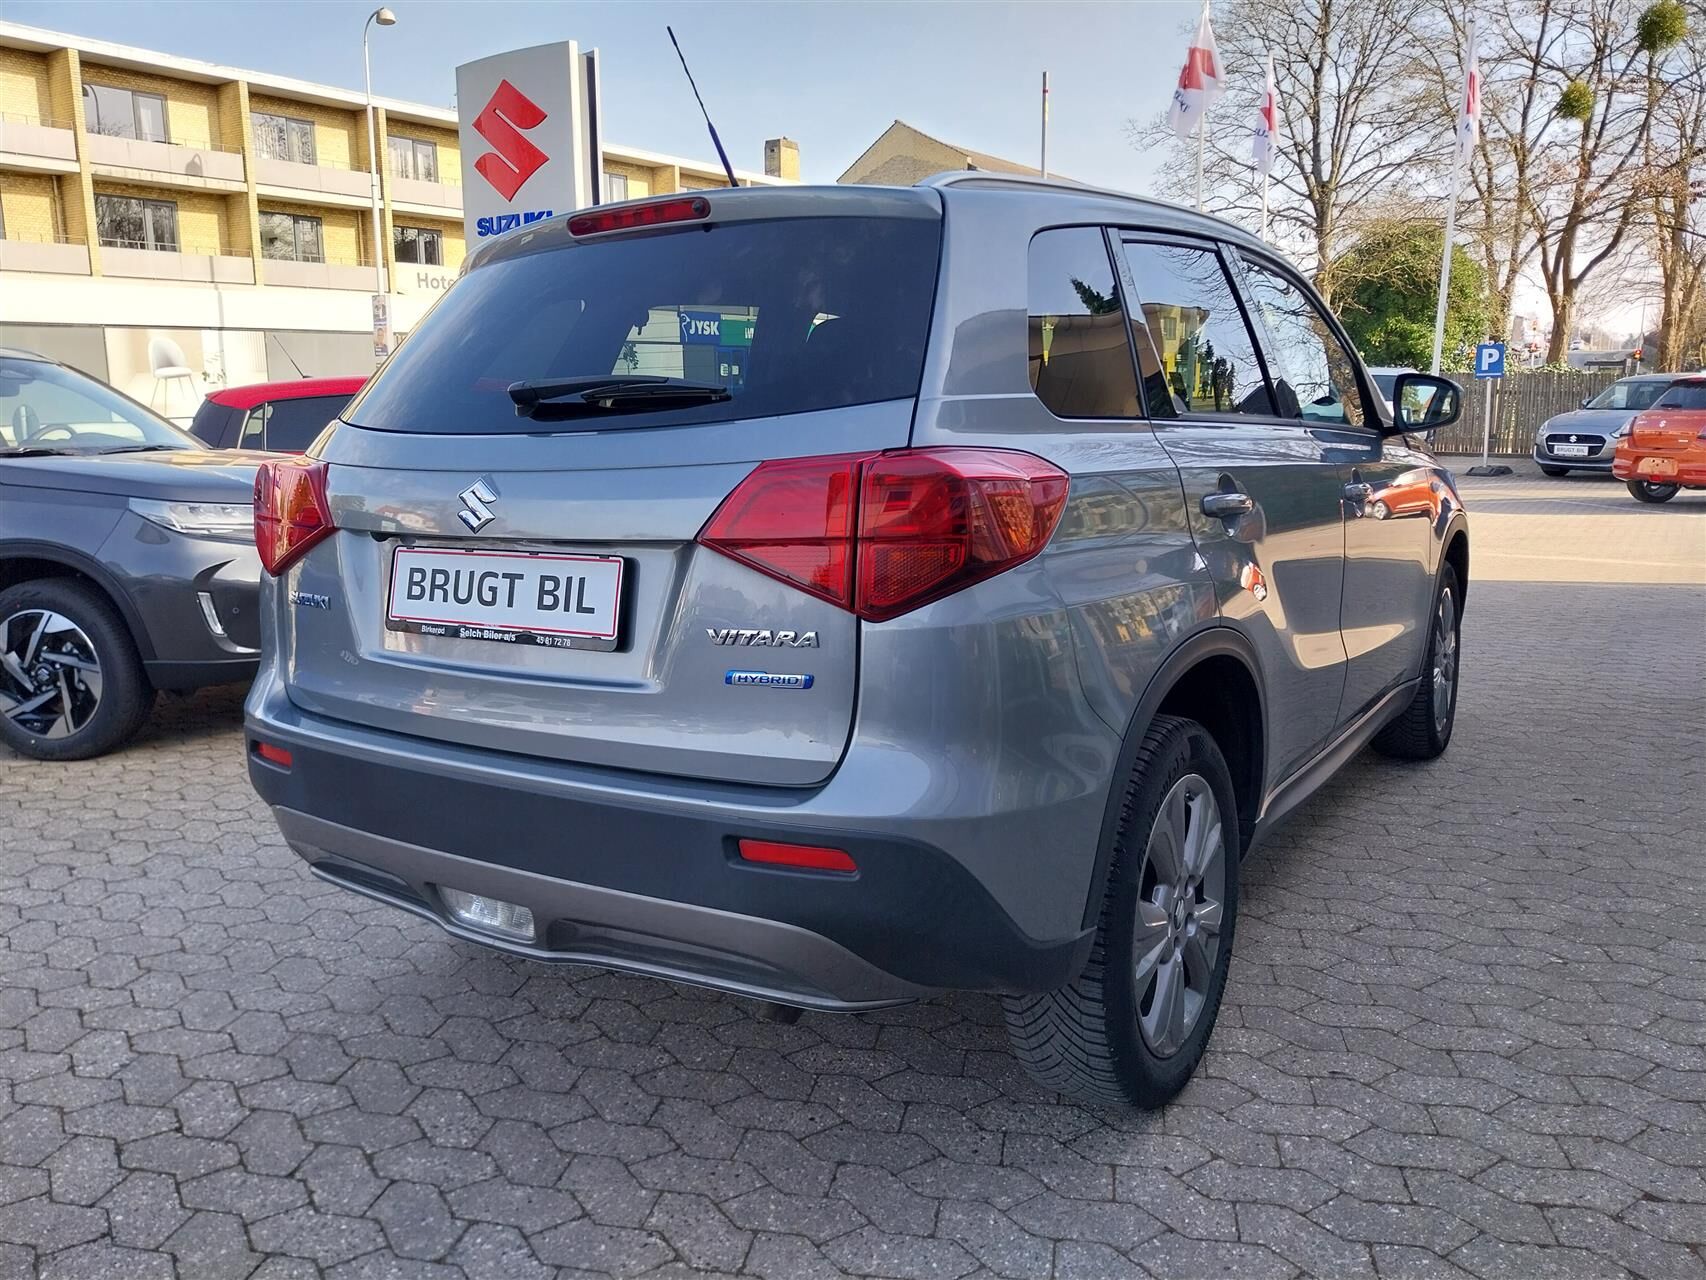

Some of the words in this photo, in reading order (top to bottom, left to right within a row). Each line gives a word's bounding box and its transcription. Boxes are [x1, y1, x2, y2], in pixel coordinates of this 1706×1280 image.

[689, 319, 720, 336] JYSK
[1481, 348, 1500, 371] P
[406, 567, 525, 608] BRUGT
[537, 575, 596, 615] BIL
[706, 628, 821, 649] VITARA
[737, 675, 799, 685] HYBRID
